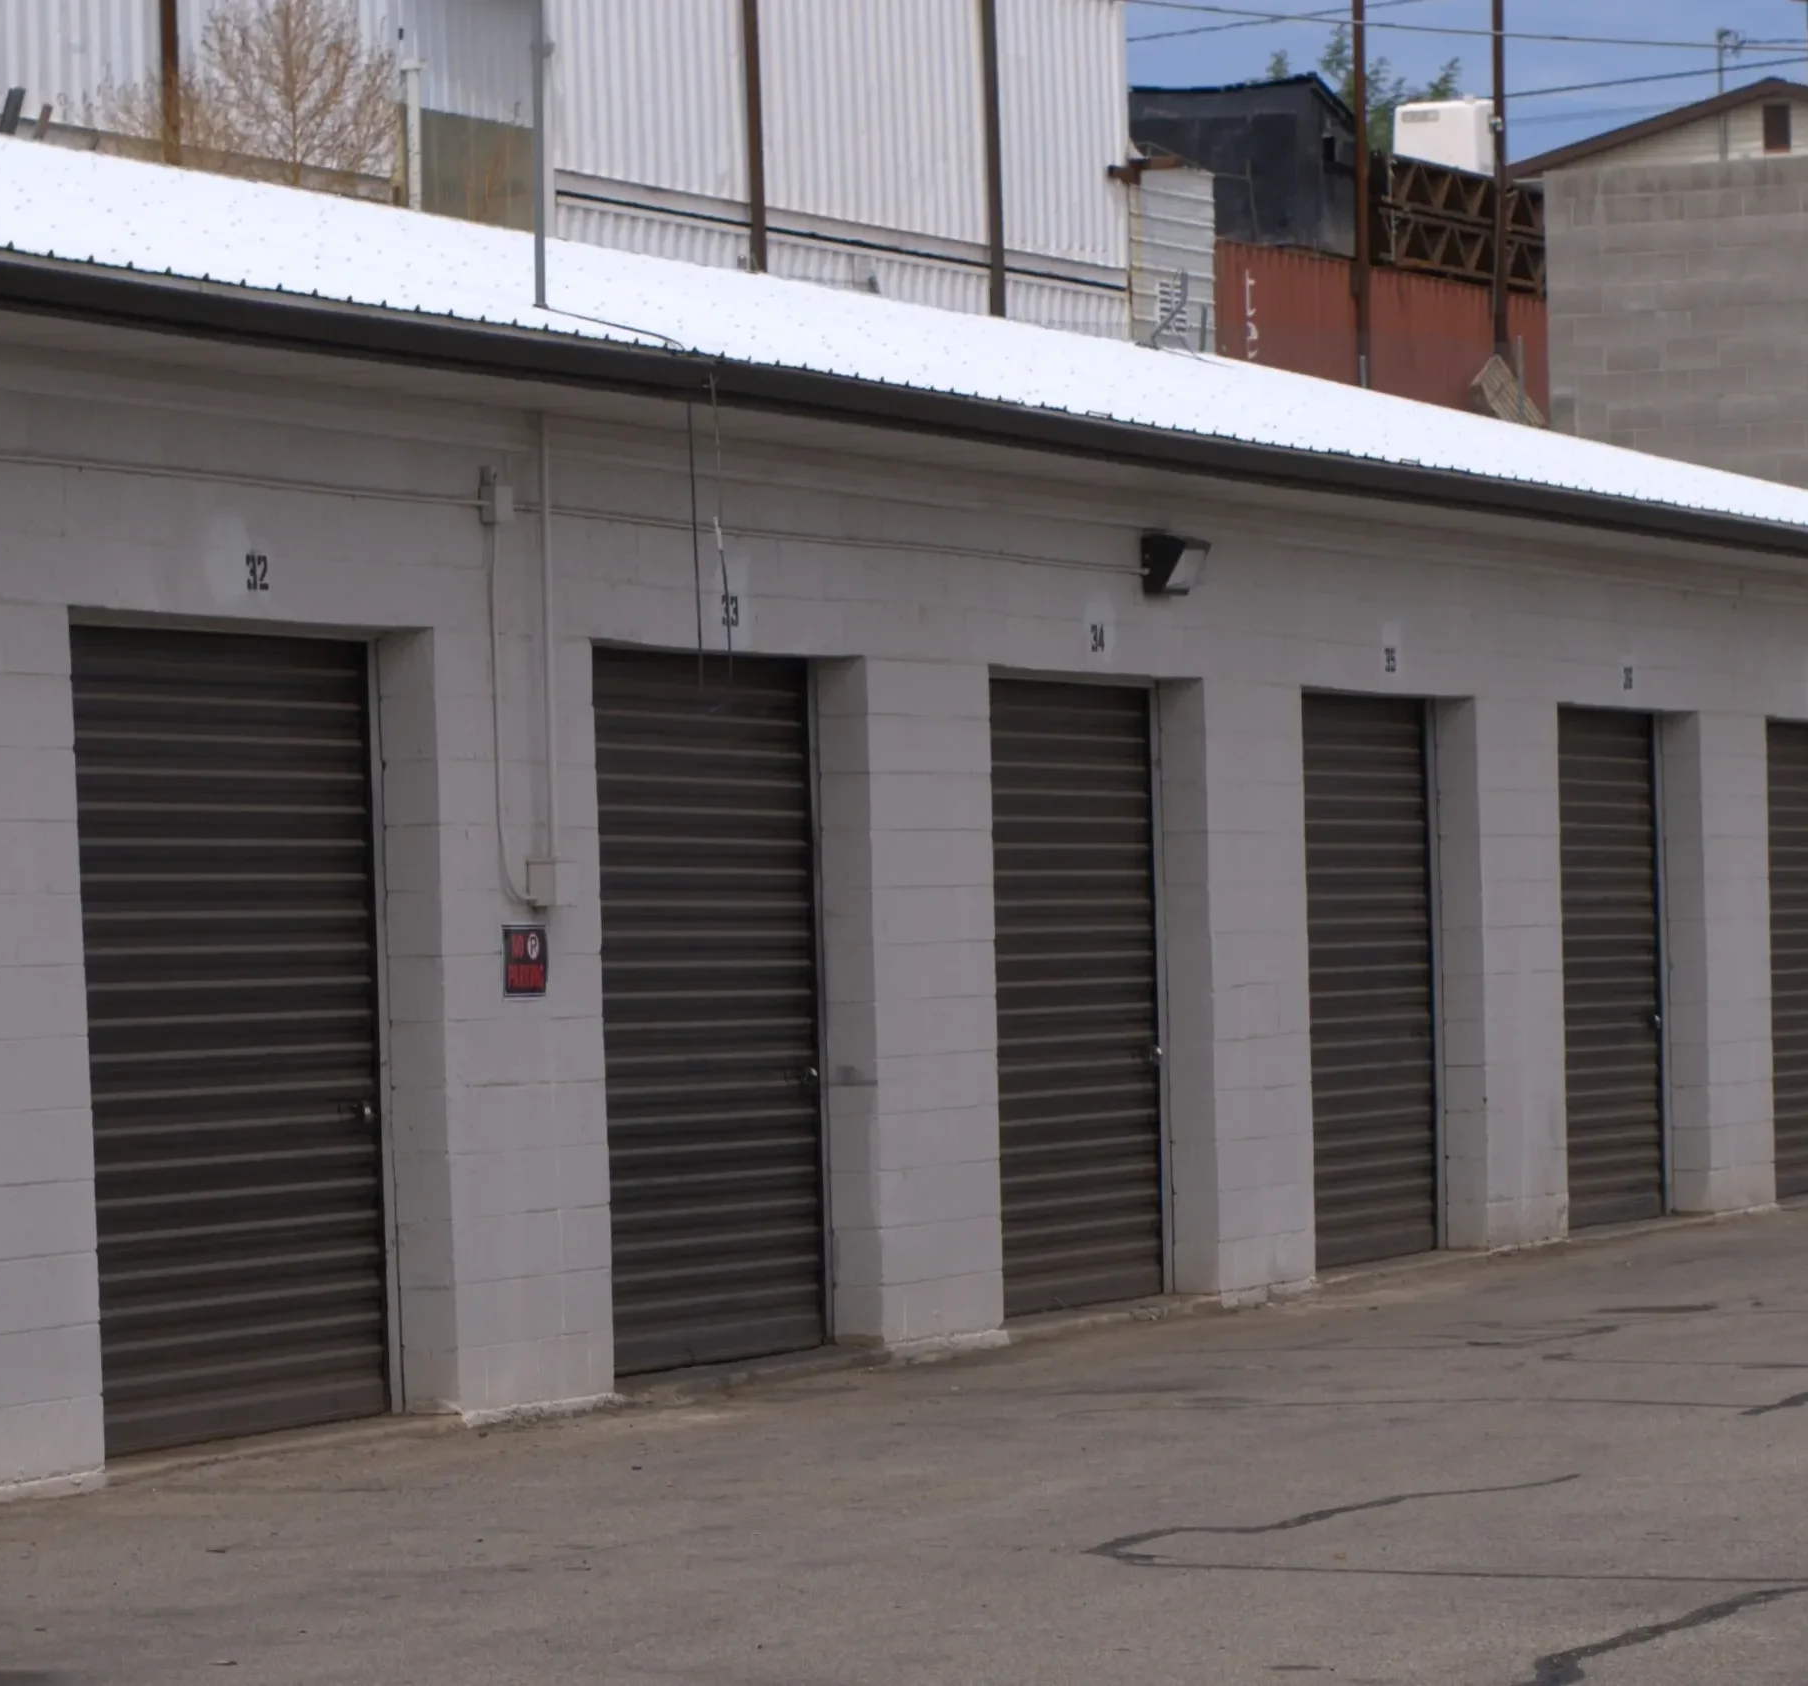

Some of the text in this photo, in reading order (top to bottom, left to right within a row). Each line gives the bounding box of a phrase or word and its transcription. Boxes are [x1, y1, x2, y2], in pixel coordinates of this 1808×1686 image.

[245, 554, 270, 591] 32
[721, 595, 740, 628] 33
[1090, 624, 1105, 652] 34
[1384, 647, 1396, 673] 35
